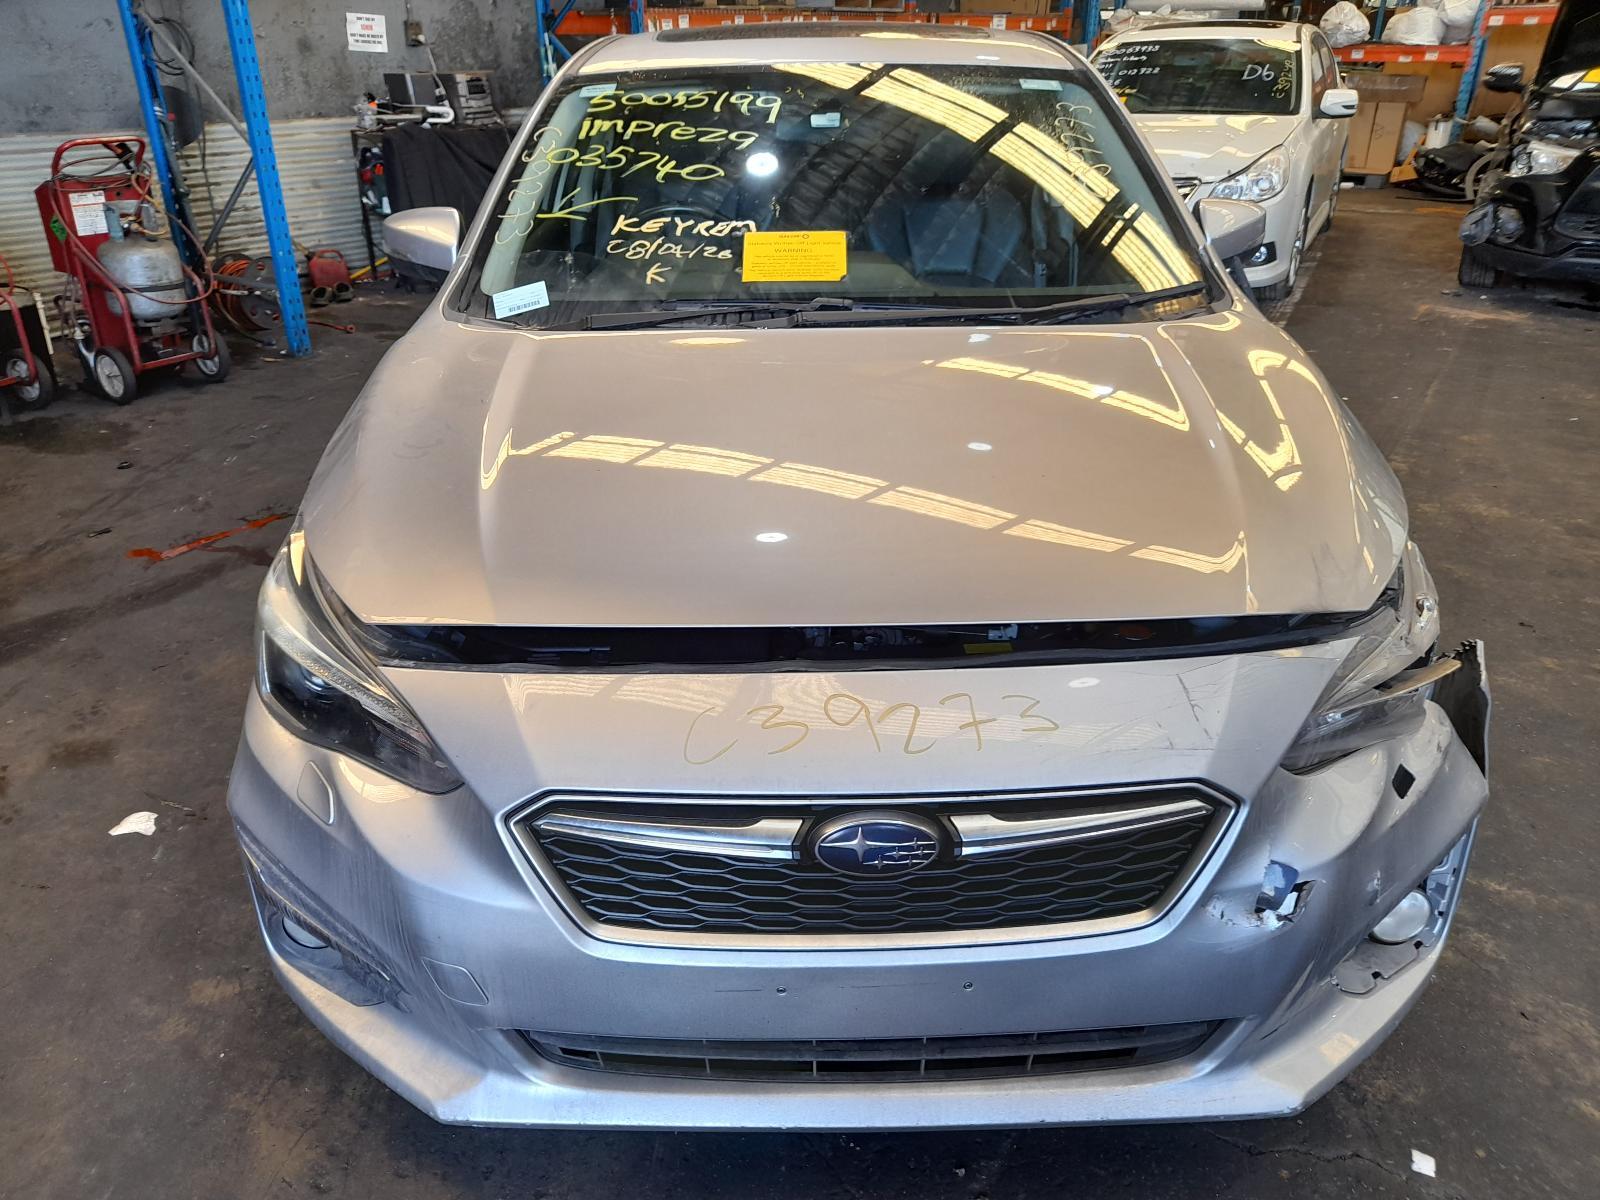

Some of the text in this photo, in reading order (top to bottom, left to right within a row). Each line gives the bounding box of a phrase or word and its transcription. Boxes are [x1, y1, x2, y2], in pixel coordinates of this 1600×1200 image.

[1241, 64, 1274, 81] D6
[587, 91, 782, 124] 50055199
[547, 145, 725, 183] 035740
[645, 262, 673, 285] K
[683, 692, 1060, 765] C39273
